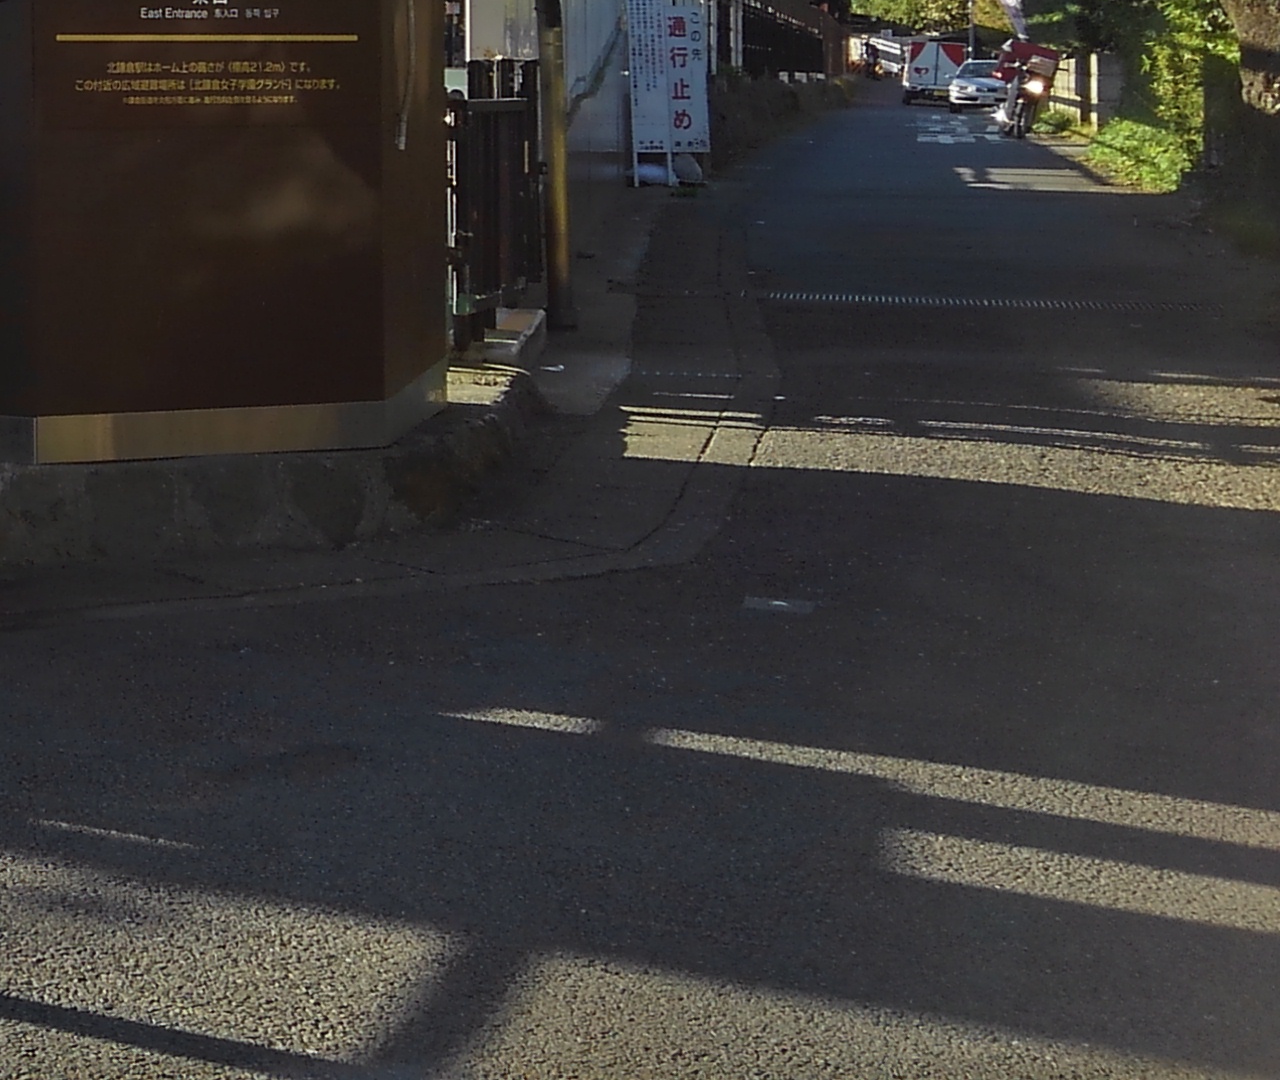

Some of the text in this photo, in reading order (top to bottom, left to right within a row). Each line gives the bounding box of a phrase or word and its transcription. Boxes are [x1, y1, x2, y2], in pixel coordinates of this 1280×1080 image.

[140, 7, 163, 19] East
[165, 7, 208, 19] Entrance
[668, 16, 692, 130] 通行止め
